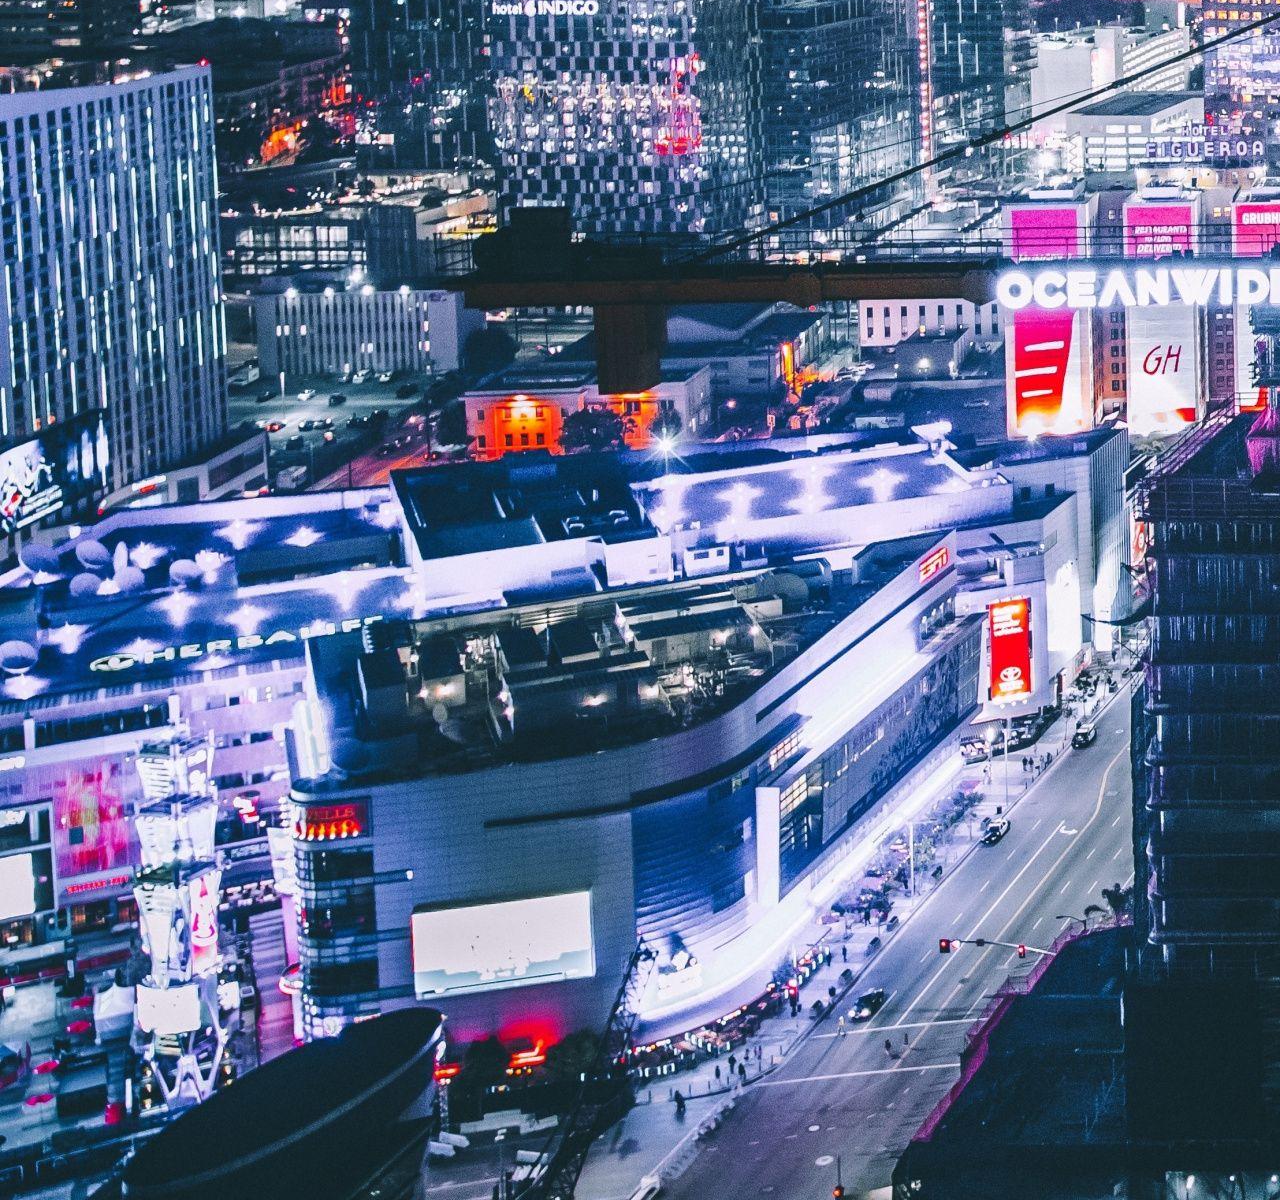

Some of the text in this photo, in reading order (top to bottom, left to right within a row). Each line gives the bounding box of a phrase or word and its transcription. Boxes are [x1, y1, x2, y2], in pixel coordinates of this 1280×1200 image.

[492, 0, 599, 15] hotel INDIGO
[1181, 125, 1232, 136] HOTEL
[1146, 141, 1264, 157] FIGUEROA
[1143, 345, 1182, 375] GH
